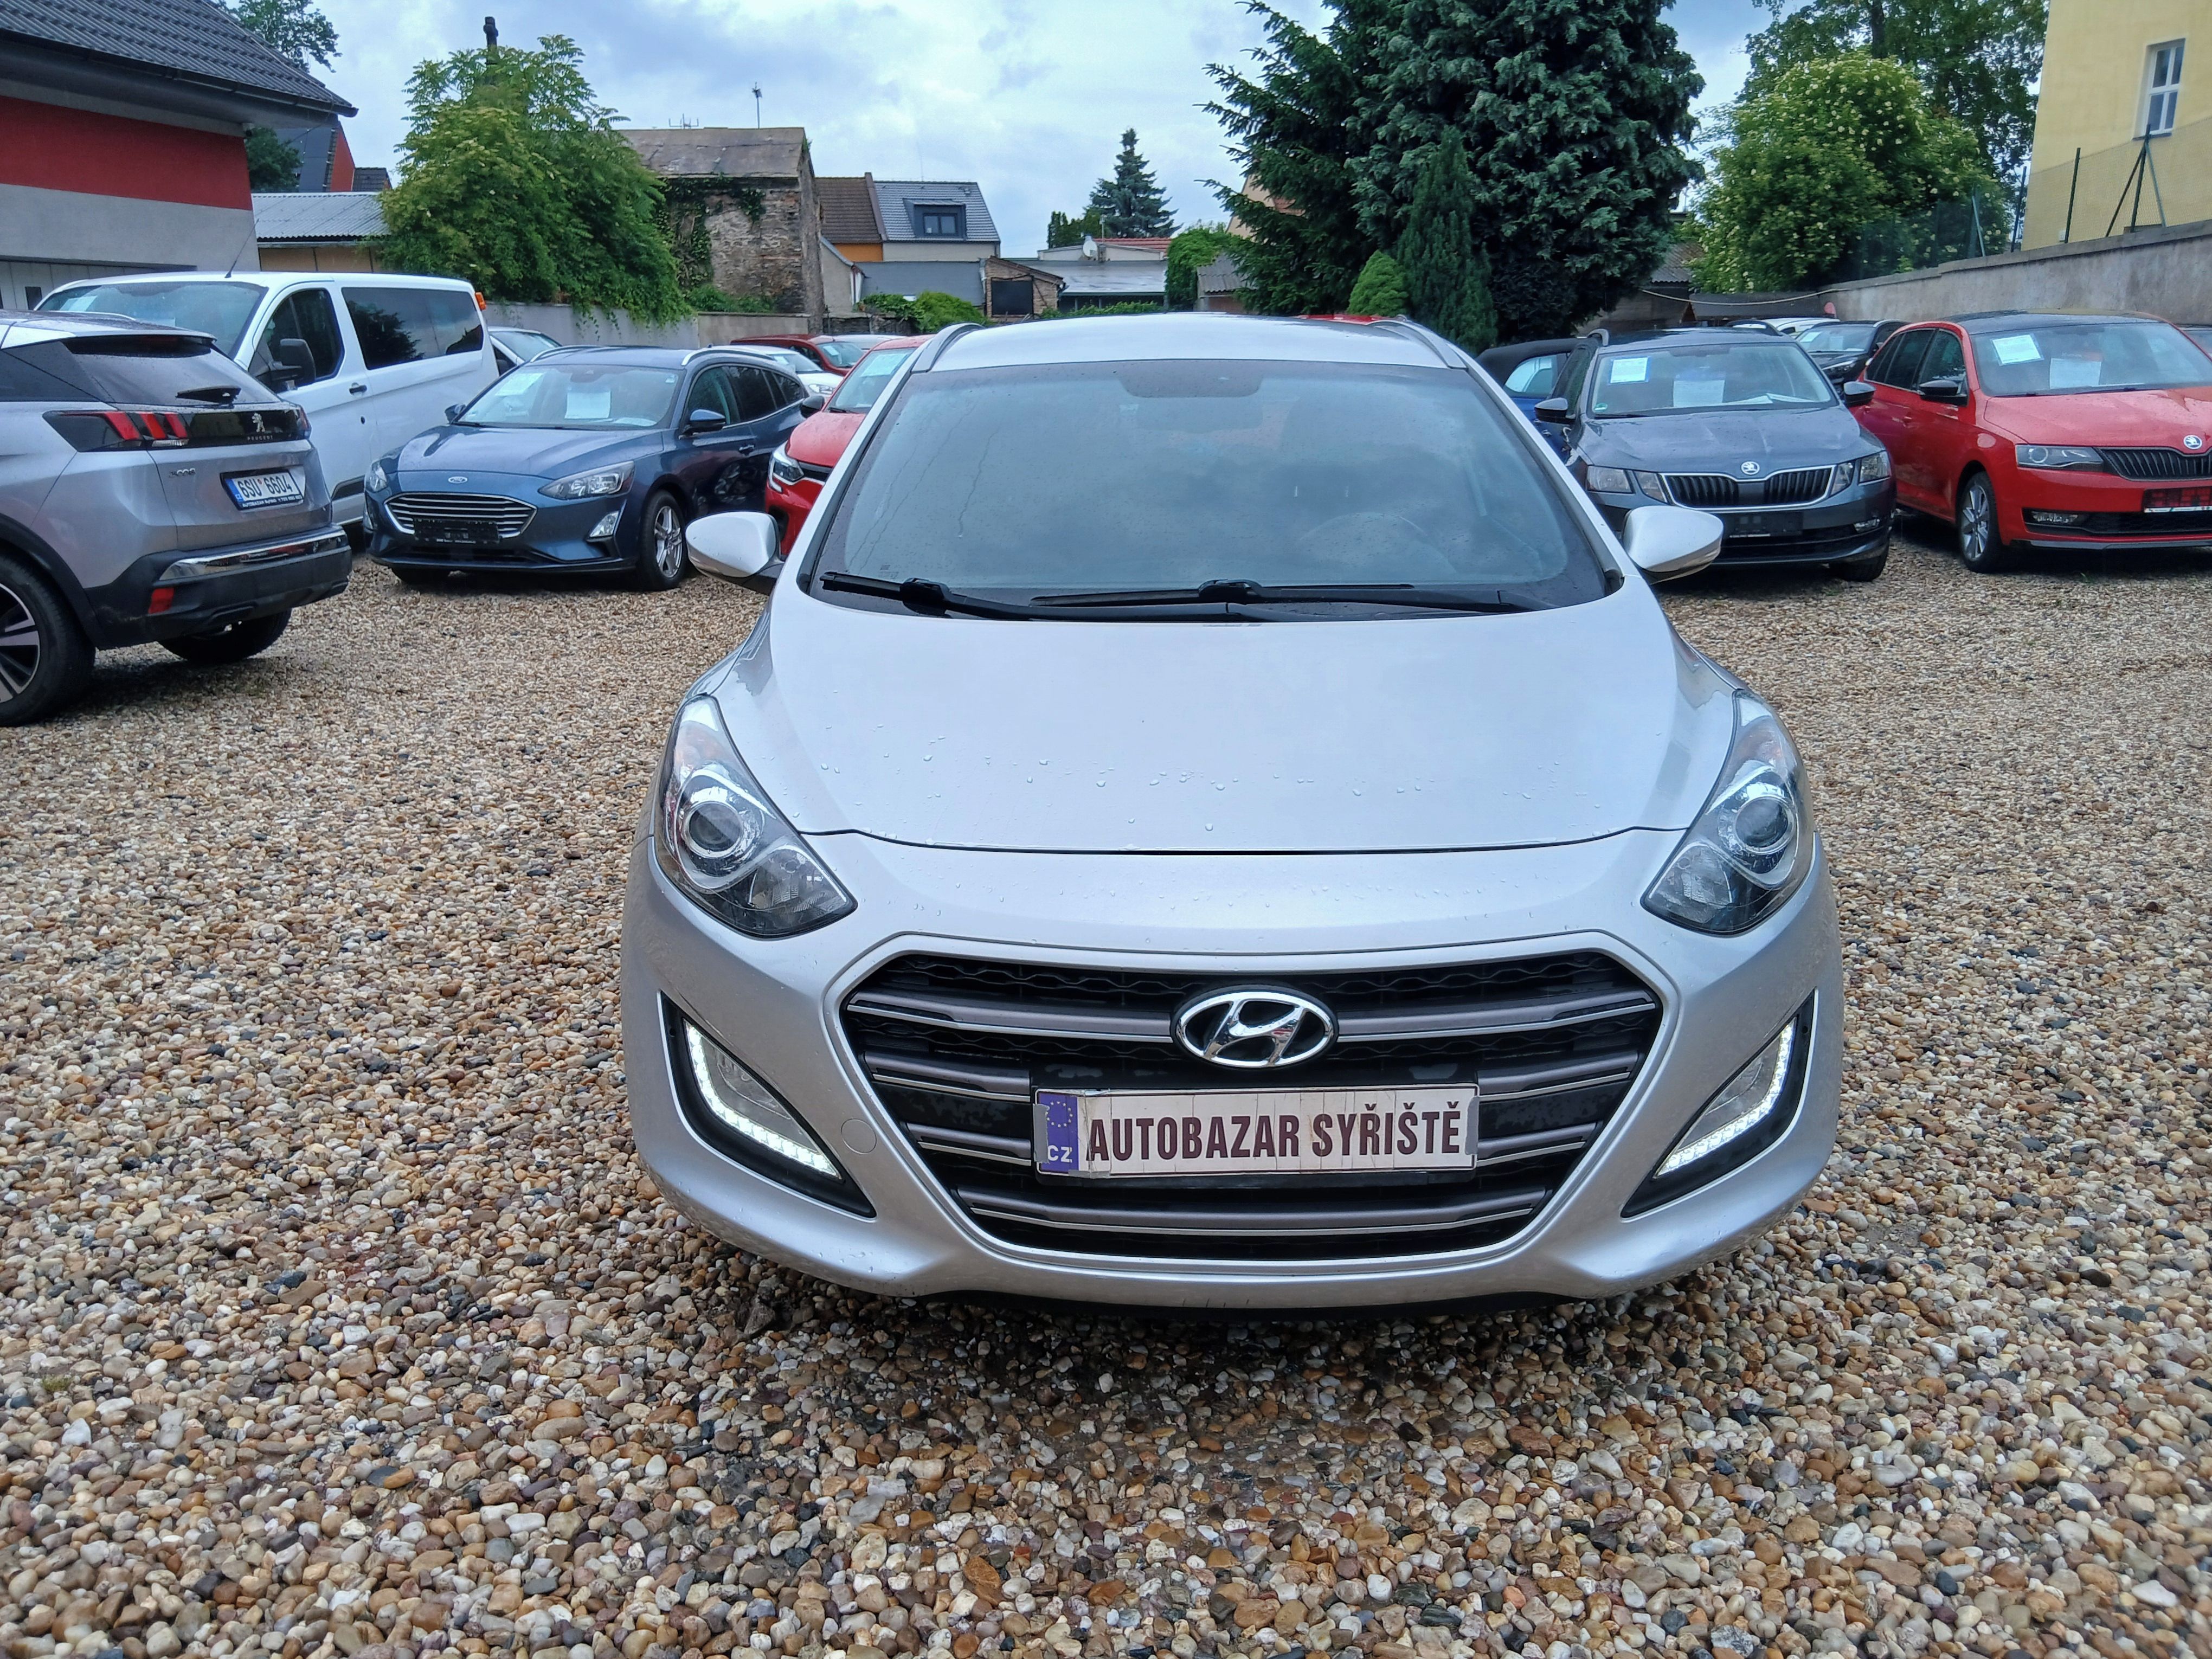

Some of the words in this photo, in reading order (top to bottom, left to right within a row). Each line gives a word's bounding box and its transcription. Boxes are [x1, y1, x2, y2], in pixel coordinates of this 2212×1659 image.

[237, 478, 262, 498] 6SU
[263, 475, 293, 494] 6604
[1086, 1115, 1300, 1161] AUTOBAZAR
[1312, 1101, 1461, 1157] SYŘIŠTĚ
[1047, 1144, 1073, 1163] CZ
